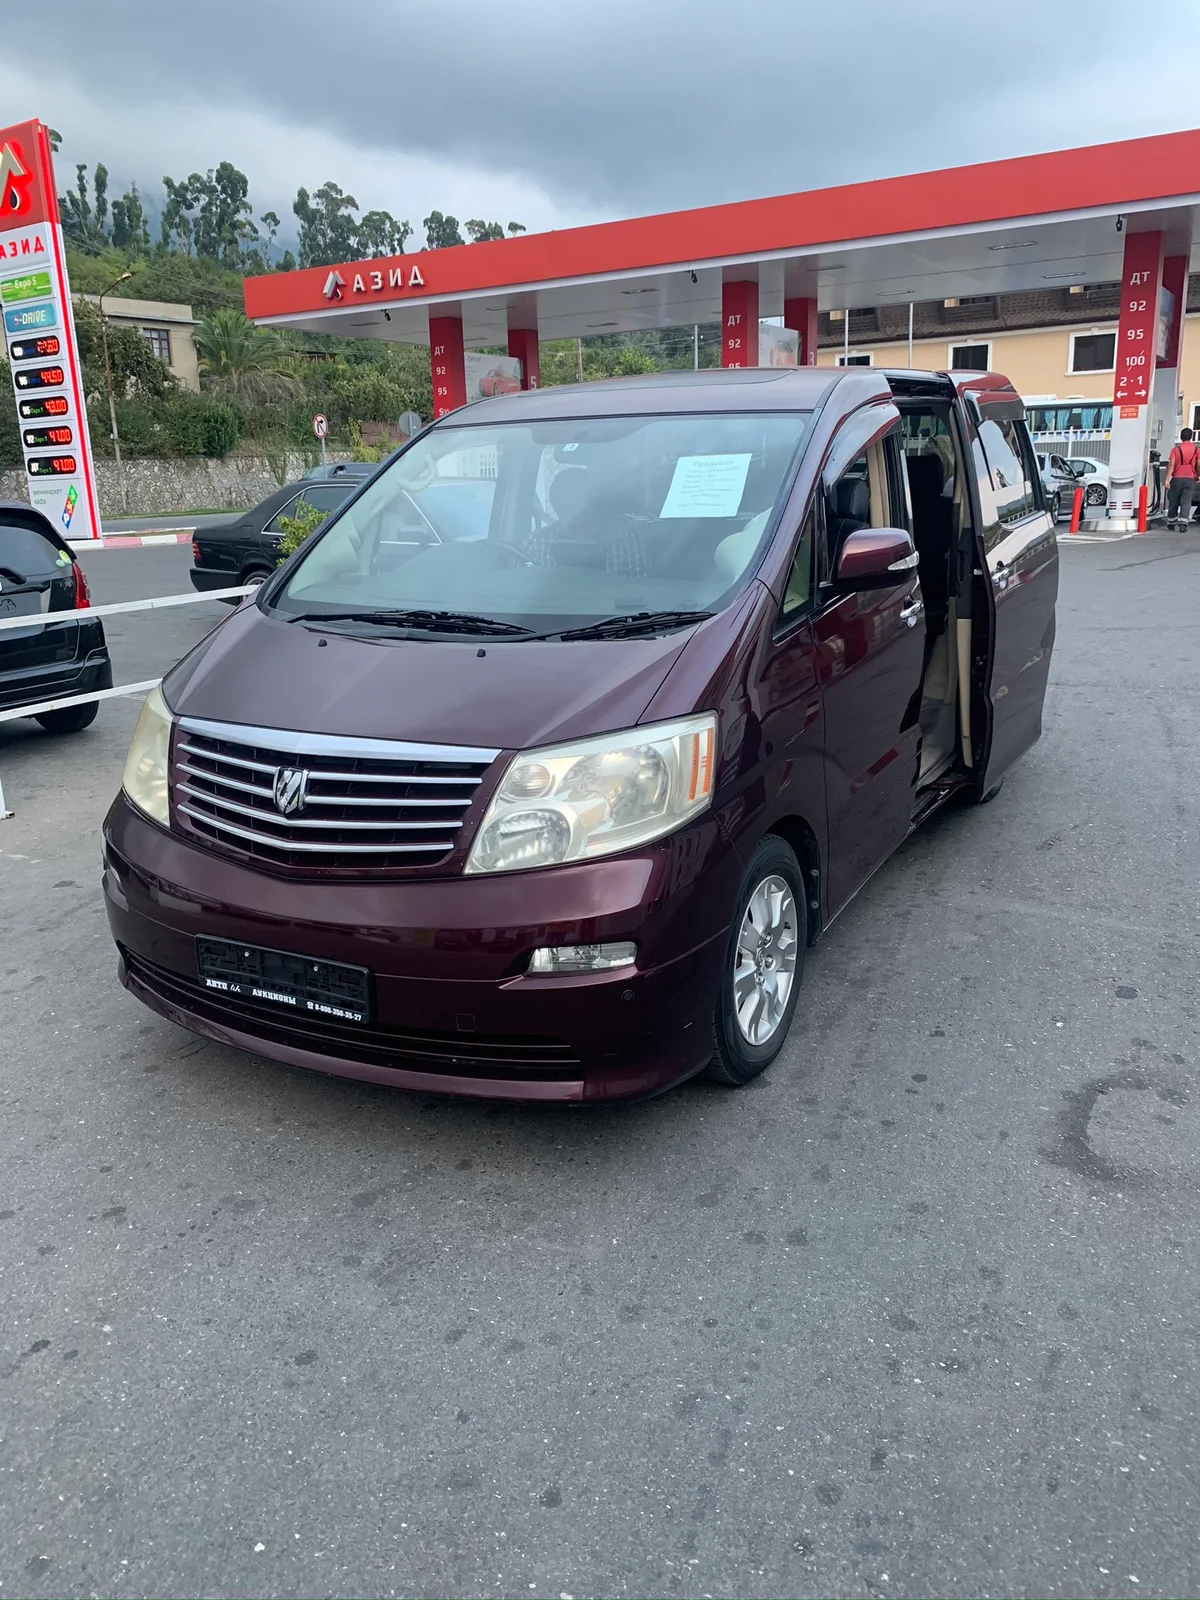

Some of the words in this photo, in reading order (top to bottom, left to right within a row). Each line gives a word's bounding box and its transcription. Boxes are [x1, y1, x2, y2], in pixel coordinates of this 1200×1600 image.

[353, 265, 424, 292] АЗИД
[1130, 271, 1150, 285] ДТ
[1129, 301, 1146, 311] 92
[14, 310, 46, 325] S-DRIVE
[728, 315, 741, 326] ДТ
[1127, 329, 1144, 340] 95
[729, 339, 741, 348] 92
[435, 346, 445, 356] ДТ
[1126, 355, 1145, 367] 100
[436, 366, 446, 375] 92
[437, 387, 448, 396] 95
[206, 979, 228, 991] АВТО
[252, 988, 297, 1005] АУКЦИОНЫ
